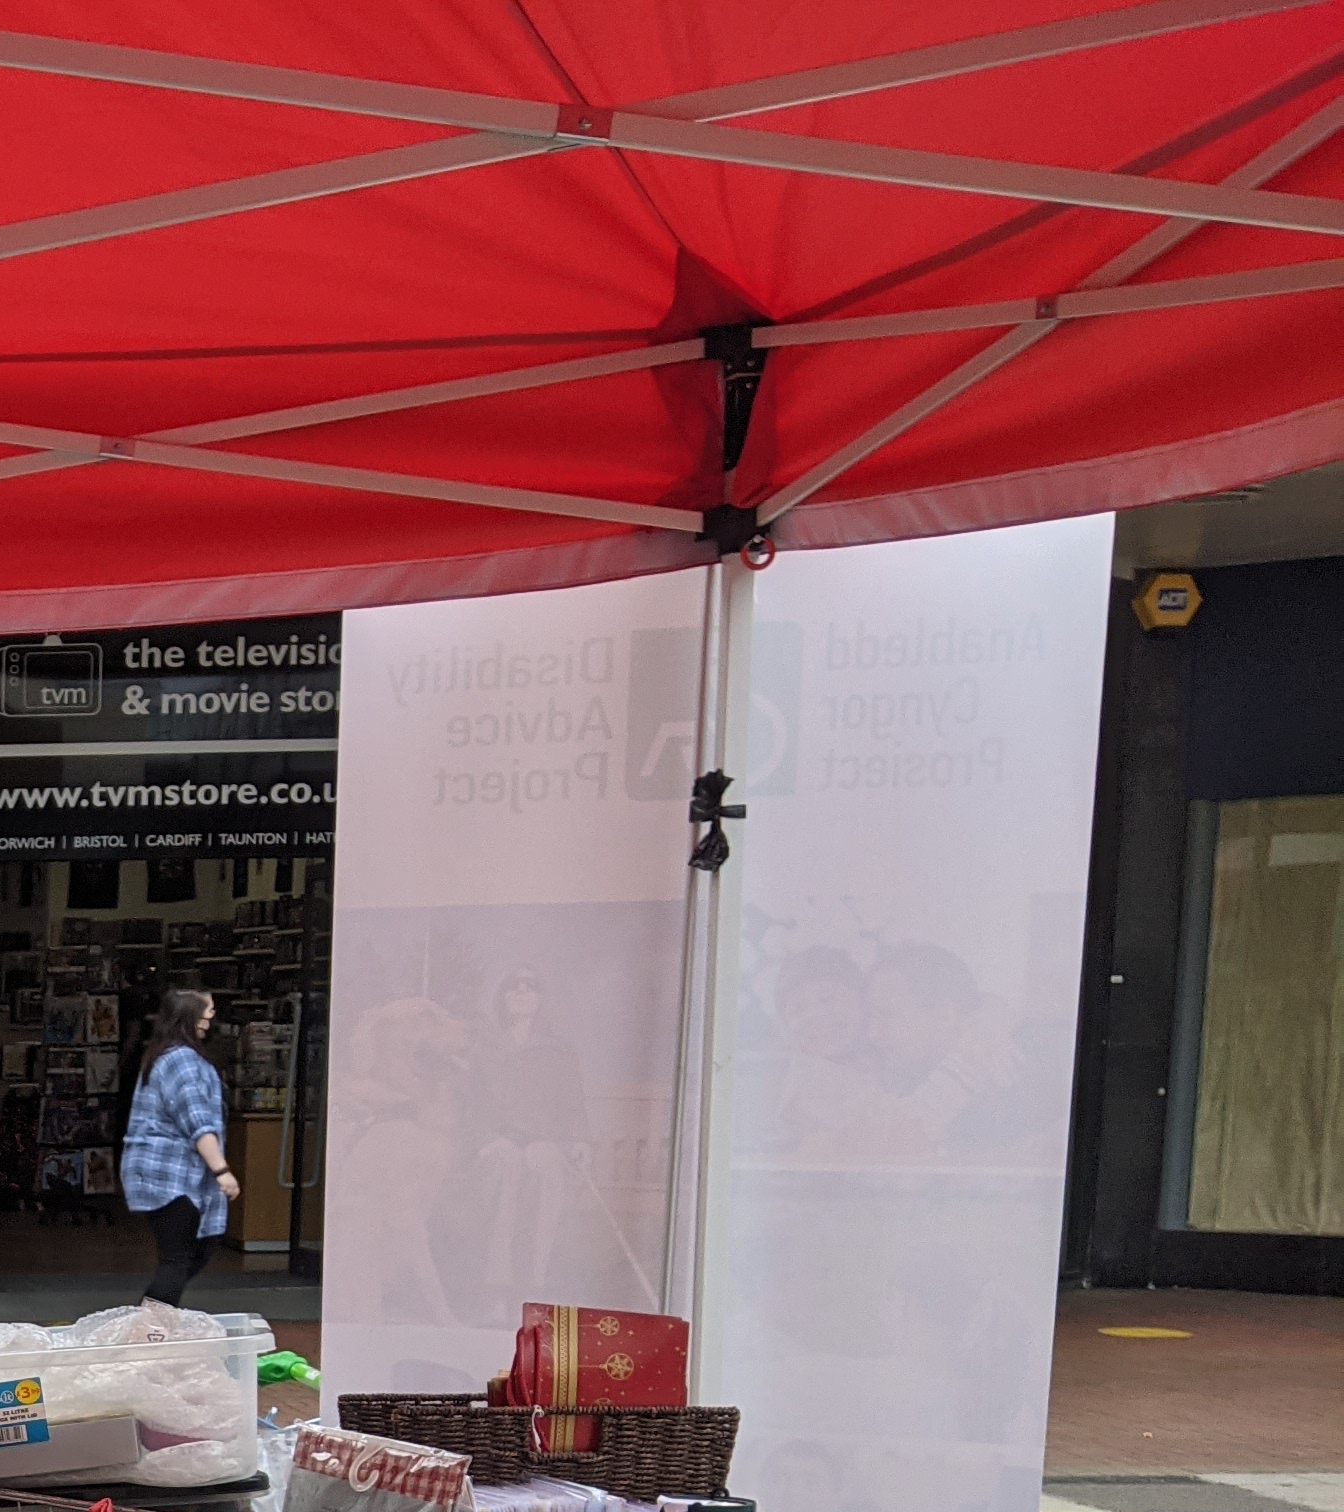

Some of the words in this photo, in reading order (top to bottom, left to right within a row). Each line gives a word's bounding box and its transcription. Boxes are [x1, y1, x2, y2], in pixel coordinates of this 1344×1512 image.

[124, 639, 184, 669] the
[41, 686, 86, 705] tvm
[121, 686, 150, 714] &
[162, 683, 270, 714] movie
[74, 836, 126, 848] BRISTOL
[146, 834, 203, 847] CARDIFF
[221, 833, 287, 845] TAUNTON
